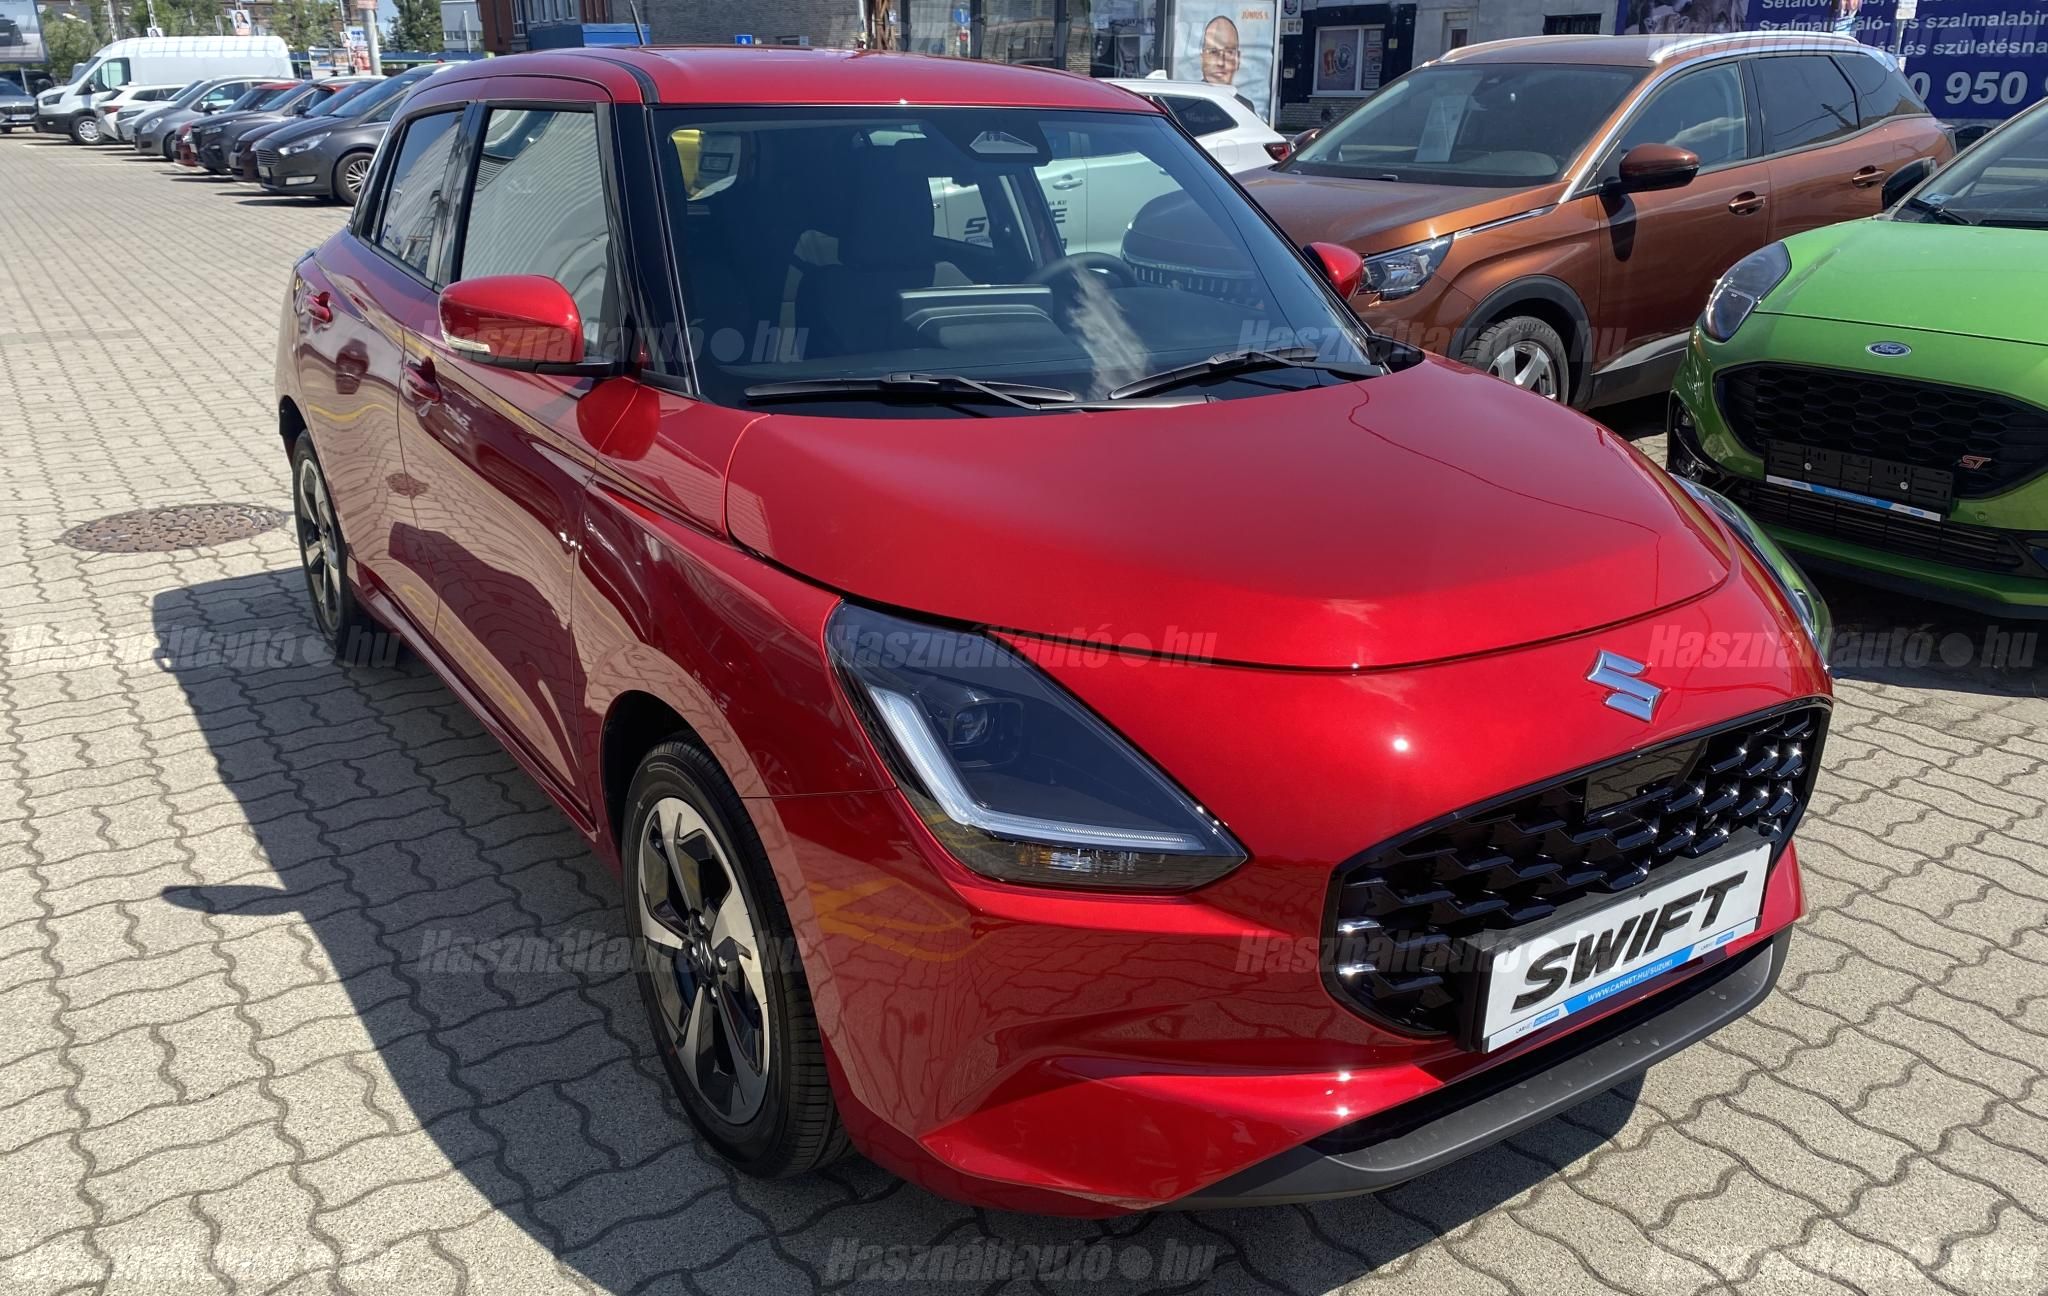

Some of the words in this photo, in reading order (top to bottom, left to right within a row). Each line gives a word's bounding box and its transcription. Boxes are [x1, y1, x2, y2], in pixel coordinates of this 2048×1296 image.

[1944, 70, 2029, 105] 950
[1959, 454, 1992, 470] ST
[1511, 870, 1748, 1014] SWIFT
[1587, 960, 1674, 1003] WWW.CARNET.HU/SUZUKI
